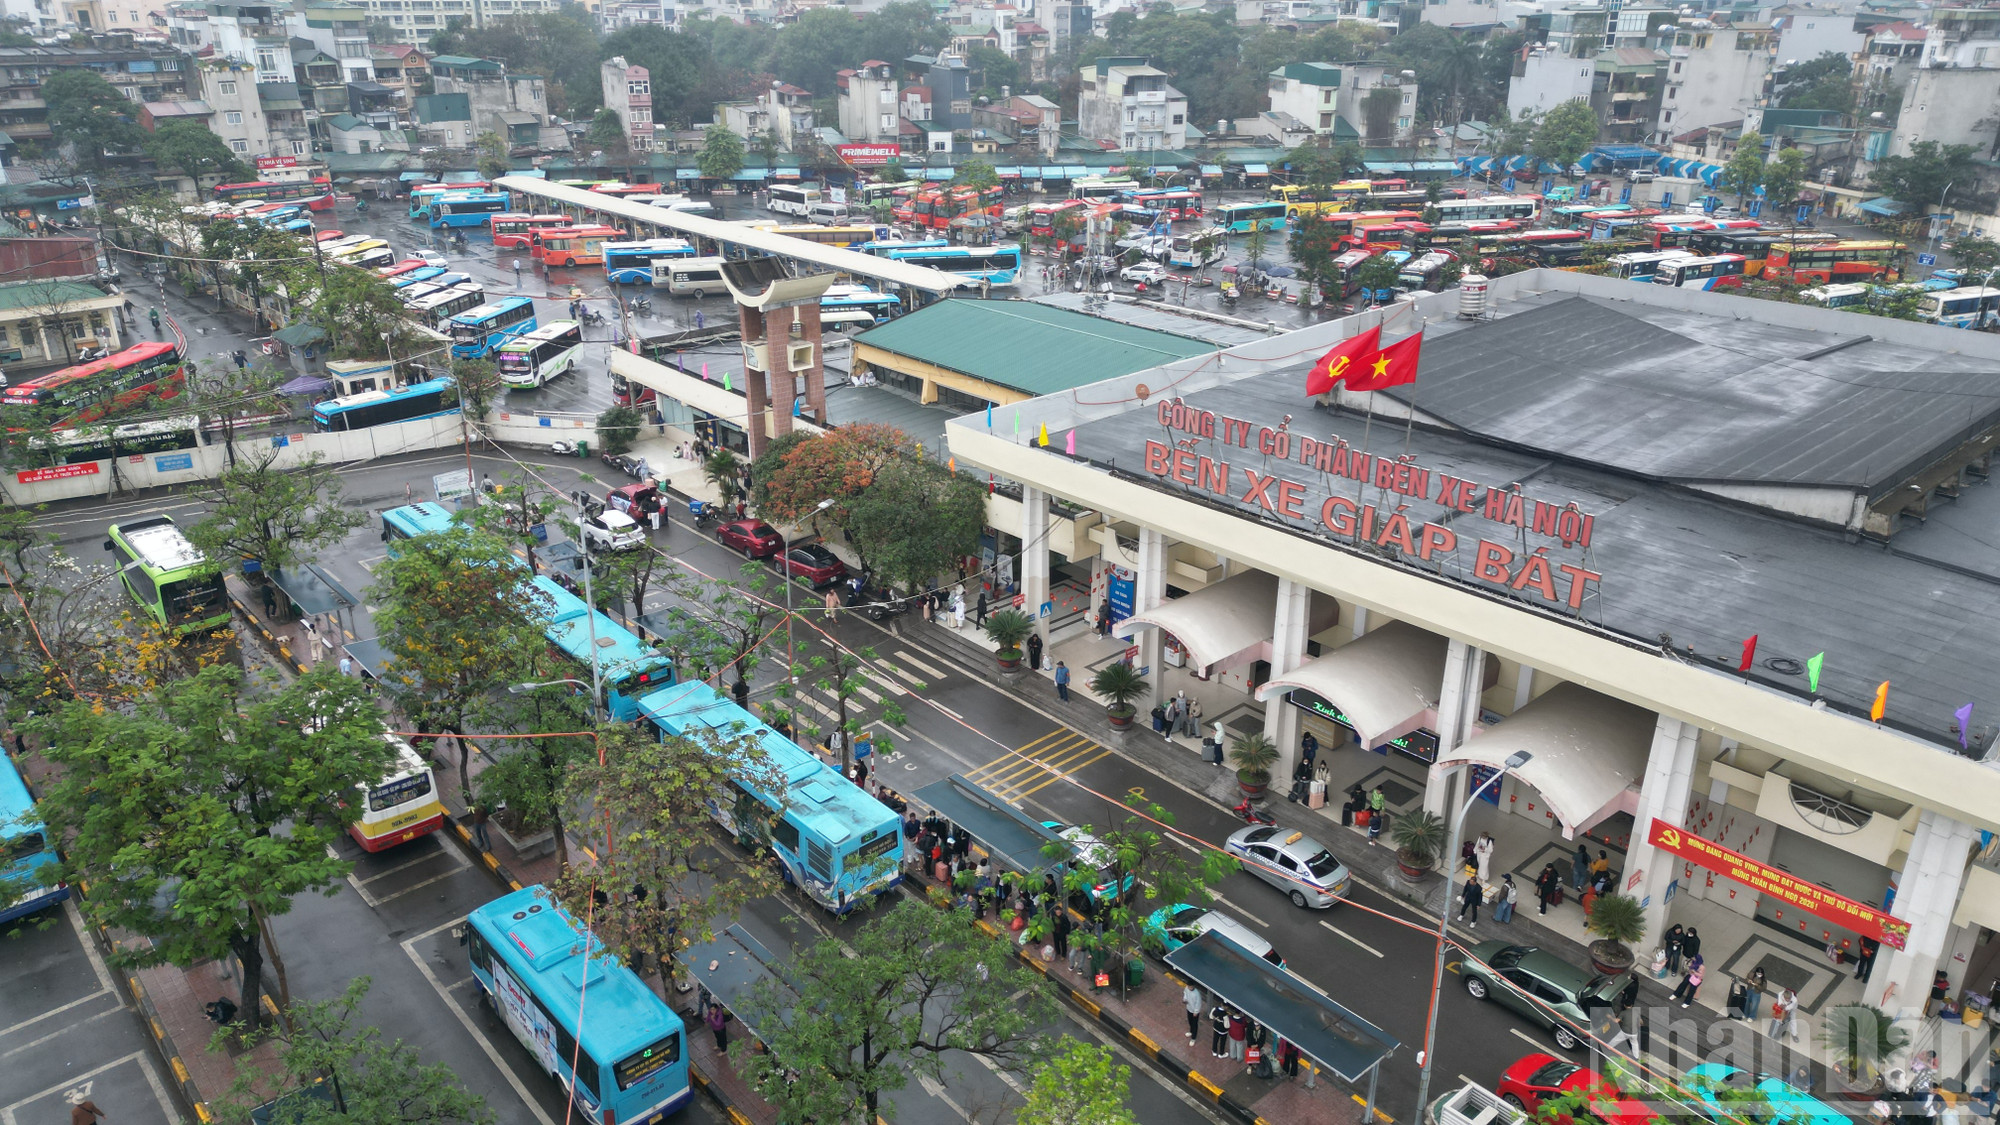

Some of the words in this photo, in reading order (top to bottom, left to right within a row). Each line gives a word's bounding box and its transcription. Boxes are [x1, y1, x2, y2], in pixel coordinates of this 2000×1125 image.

[841, 147, 896, 156] PRIMEWELL
[1158, 397, 1214, 439] CÔNG
[1222, 415, 1252, 448] TY
[1259, 414, 1293, 460] CỔ
[1300, 434, 1372, 483] PHẦN
[1375, 454, 1430, 500] BẾN
[1436, 472, 1478, 514] XE
[1484, 482, 1525, 529] HÀ
[1532, 501, 1595, 549] NỘI
[1145, 438, 1230, 496] BẾN
[1241, 467, 1306, 520] XE
[1321, 496, 1458, 561] GIÁP
[1474, 538, 1602, 609] BÁT
[882, 751, 905, 764] 22
[904, 762, 918, 771] C
[1687, 837, 1705, 851] MỪNG
[1706, 845, 1722, 858] ĐẢNG
[1723, 853, 1743, 867] QUANG
[1744, 861, 1760, 875] VINH,
[1761, 869, 1780, 883] MỪNG
[1813, 890, 1821, 900] VÀ
[1836, 899, 1846, 910] ĐÔ
[1731, 867, 1750, 881] MỪNG
[1751, 876, 1768, 889] XUÂN
[1768, 883, 1784, 896] BÍNH
[1784, 890, 1798, 903] NGỌ
